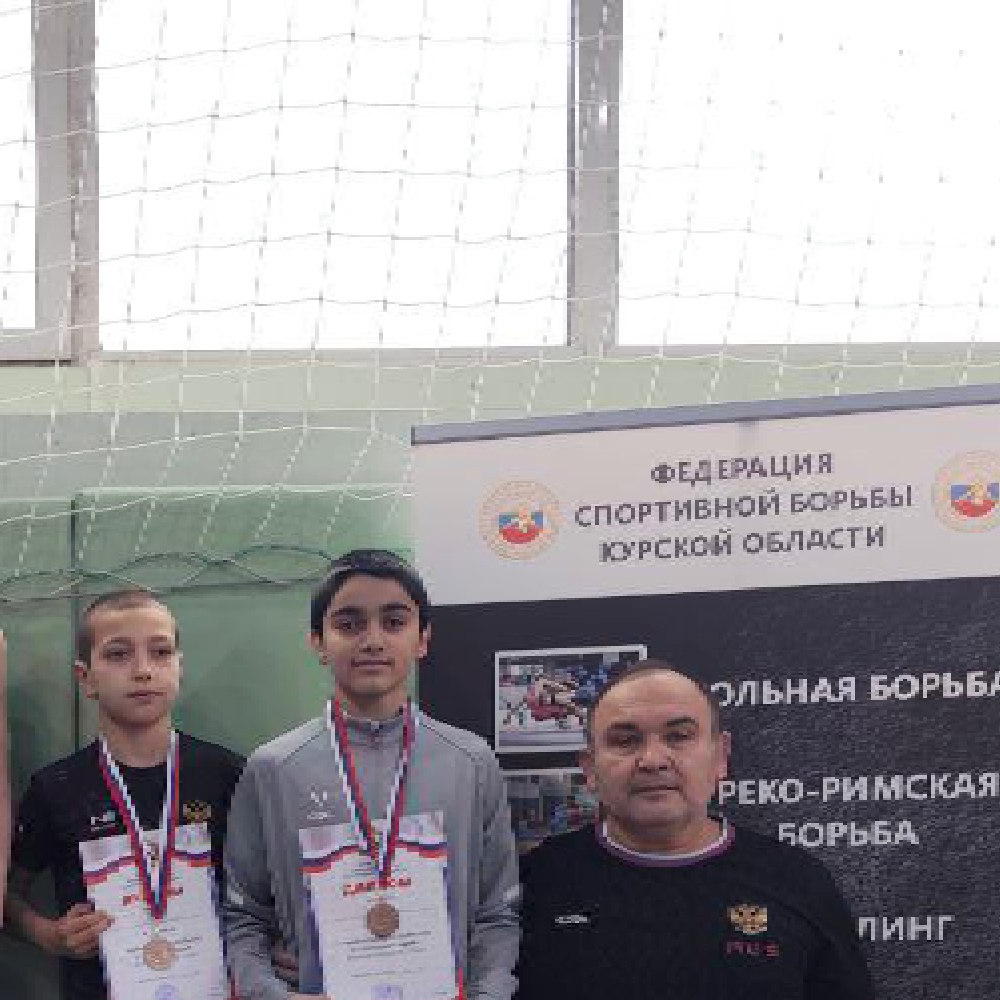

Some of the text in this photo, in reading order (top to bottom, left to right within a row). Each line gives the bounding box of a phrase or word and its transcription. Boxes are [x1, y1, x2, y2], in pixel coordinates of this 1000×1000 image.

[651, 453, 832, 487] ФЕДЕРАЦИЯ
[575, 485, 912, 527] СПОРТИВНОЙ БОРЬБЫ
[600, 526, 884, 563] КУРСКОЙ ОБЛАСТИ
[778, 820, 920, 848] БОРЬБА
